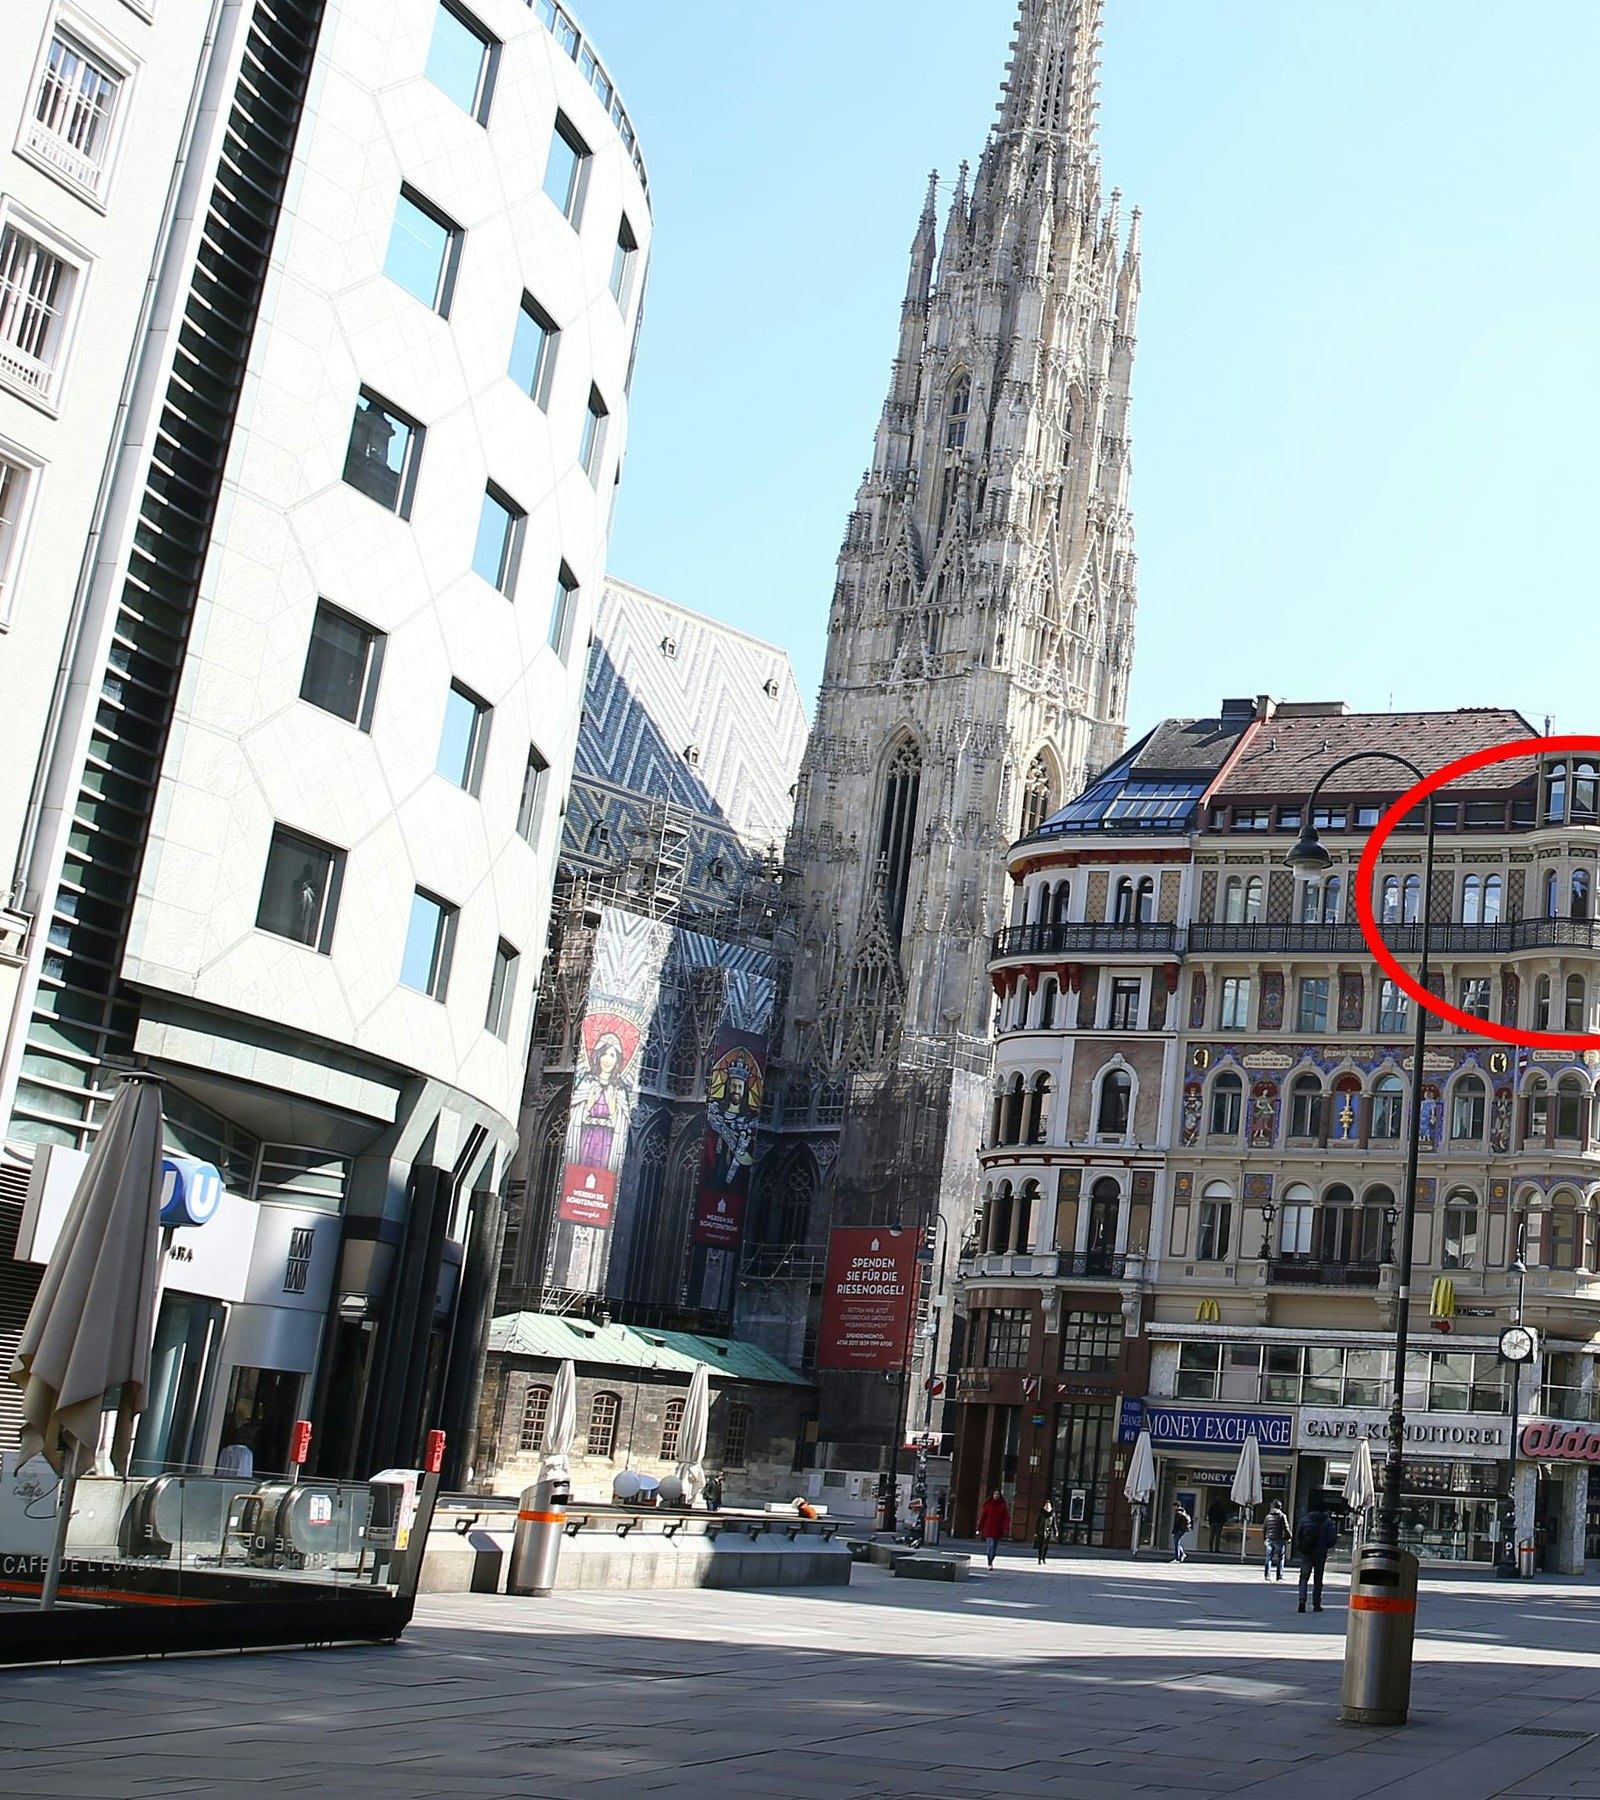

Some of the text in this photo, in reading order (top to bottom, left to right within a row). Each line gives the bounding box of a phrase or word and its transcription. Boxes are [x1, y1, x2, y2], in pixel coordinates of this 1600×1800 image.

[190, 1172, 220, 1218] U
[169, 1245, 194, 1263] ARA
[852, 1258, 895, 1268] SPENDEN
[284, 1260, 310, 1290] HAUS
[846, 1268, 898, 1282] SIE FÜR DIE
[837, 1284, 904, 1295] RIESENORGEL!
[1146, 1414, 1201, 1438] MONEY
[1204, 1417, 1290, 1443] EXCHANGE
[1193, 1472, 1228, 1482] MONEY
